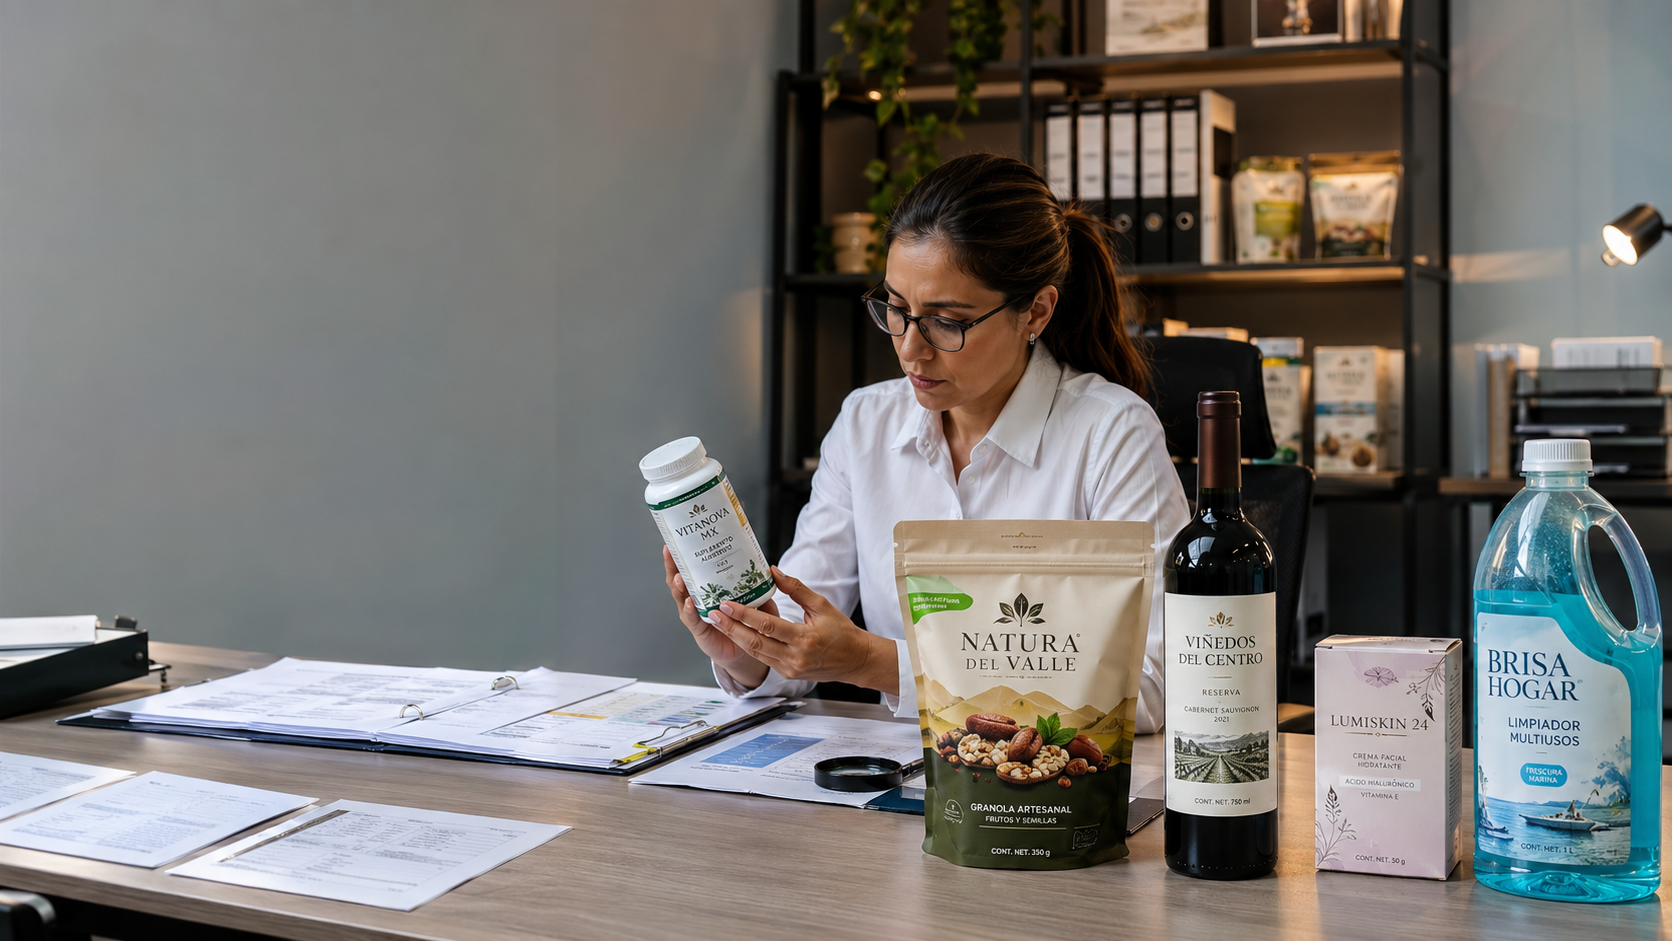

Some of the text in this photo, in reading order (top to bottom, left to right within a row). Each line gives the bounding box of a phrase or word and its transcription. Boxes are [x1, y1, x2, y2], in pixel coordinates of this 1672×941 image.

[675, 508, 730, 537] VITANOVA
[700, 526, 719, 541] MX
[961, 632, 1080, 653] NATURA
[1185, 633, 1256, 650] VIÑEDOS
[965, 656, 1076, 672] DEL VALLE
[1178, 652, 1263, 667] DEL CENTRO
[1487, 649, 1572, 677] BRISA
[1202, 688, 1241, 697] RESERVA
[1488, 676, 1580, 701] HOGAR
[1184, 705, 1260, 714] CABERNET SAUVIGNON
[1330, 714, 1429, 731] LUMISKIN 24
[1508, 716, 1581, 732] LIMPIADOR
[1510, 732, 1580, 747] MULTIUSOS
[1352, 752, 1407, 762] CREMA FACIAL
[1194, 797, 1214, 805] CONT.
[1215, 798, 1230, 806] NET.
[1231, 798, 1242, 806] 750
[1360, 791, 1393, 799] VITAMINA
[970, 802, 1072, 814] GRANOLA ARTESANAL
[985, 815, 1014, 824] FRUTOS
[1015, 816, 1021, 824] Y
[991, 847, 1013, 855] CONT.
[1045, 849, 1051, 858] g
[1520, 842, 1543, 852] CONT.
[1355, 854, 1375, 862] CONT.
[1375, 856, 1391, 864] NET.
